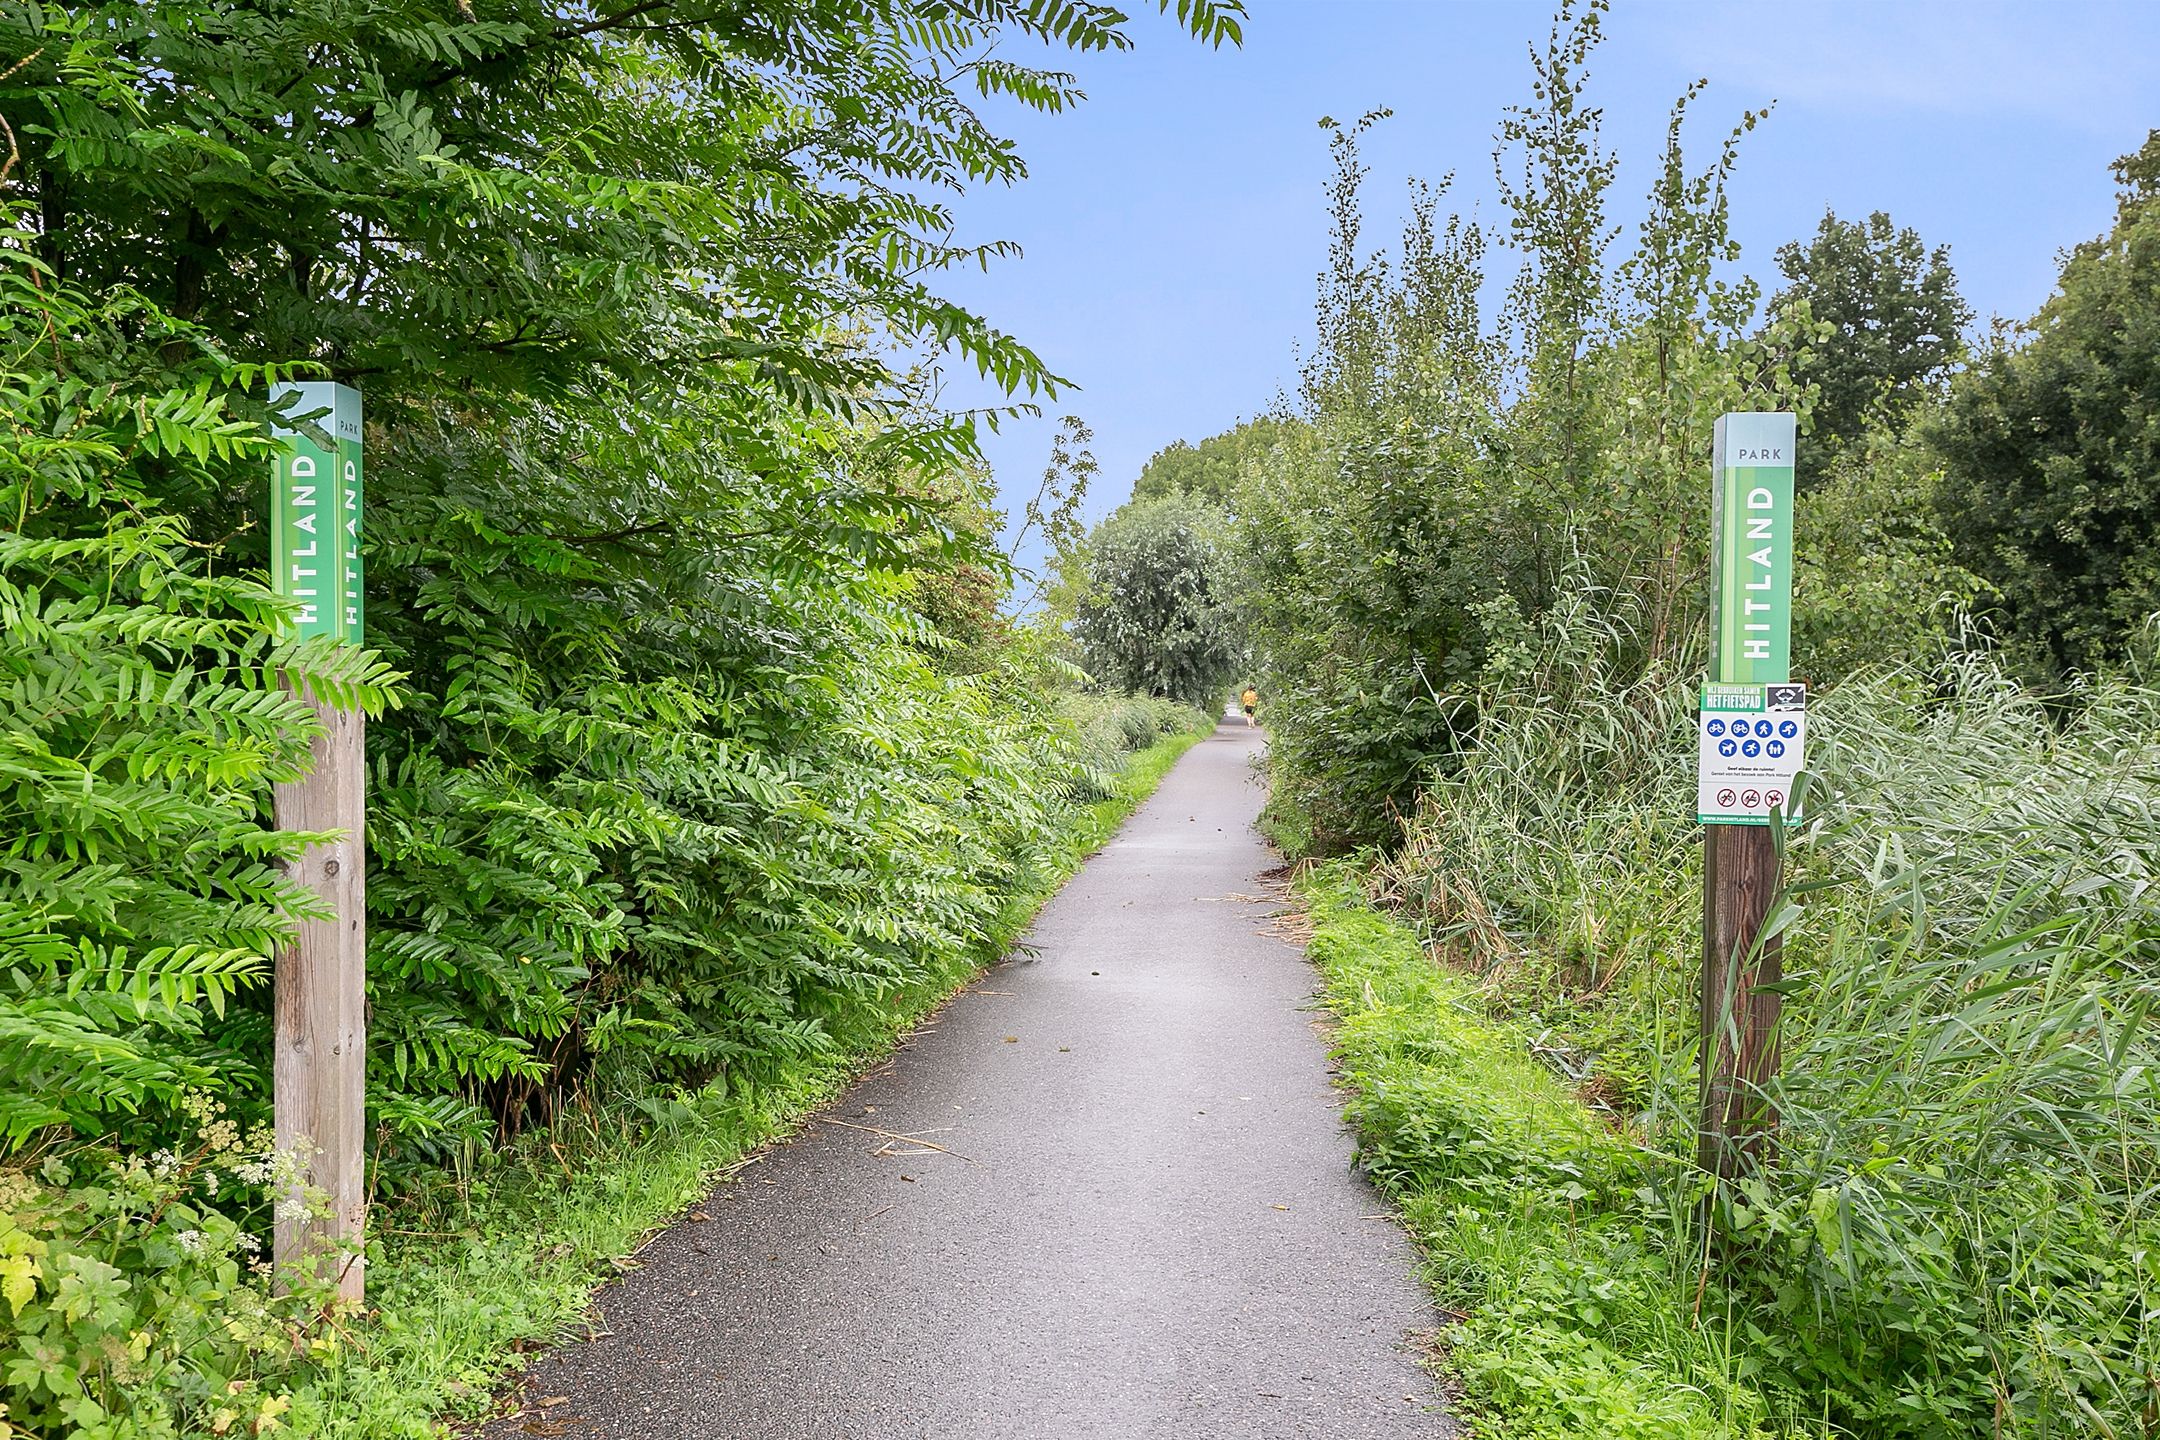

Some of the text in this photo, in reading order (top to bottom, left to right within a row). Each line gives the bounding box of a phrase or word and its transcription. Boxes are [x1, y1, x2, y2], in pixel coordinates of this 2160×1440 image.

[340, 420, 358, 435] PARK
[1739, 449, 1781, 460] PARK
[291, 455, 318, 624] HITLAND
[344, 459, 357, 625] HITLAND
[1743, 487, 1773, 659] HITLAND
[1707, 694, 1761, 709] HET FIETSPAD
